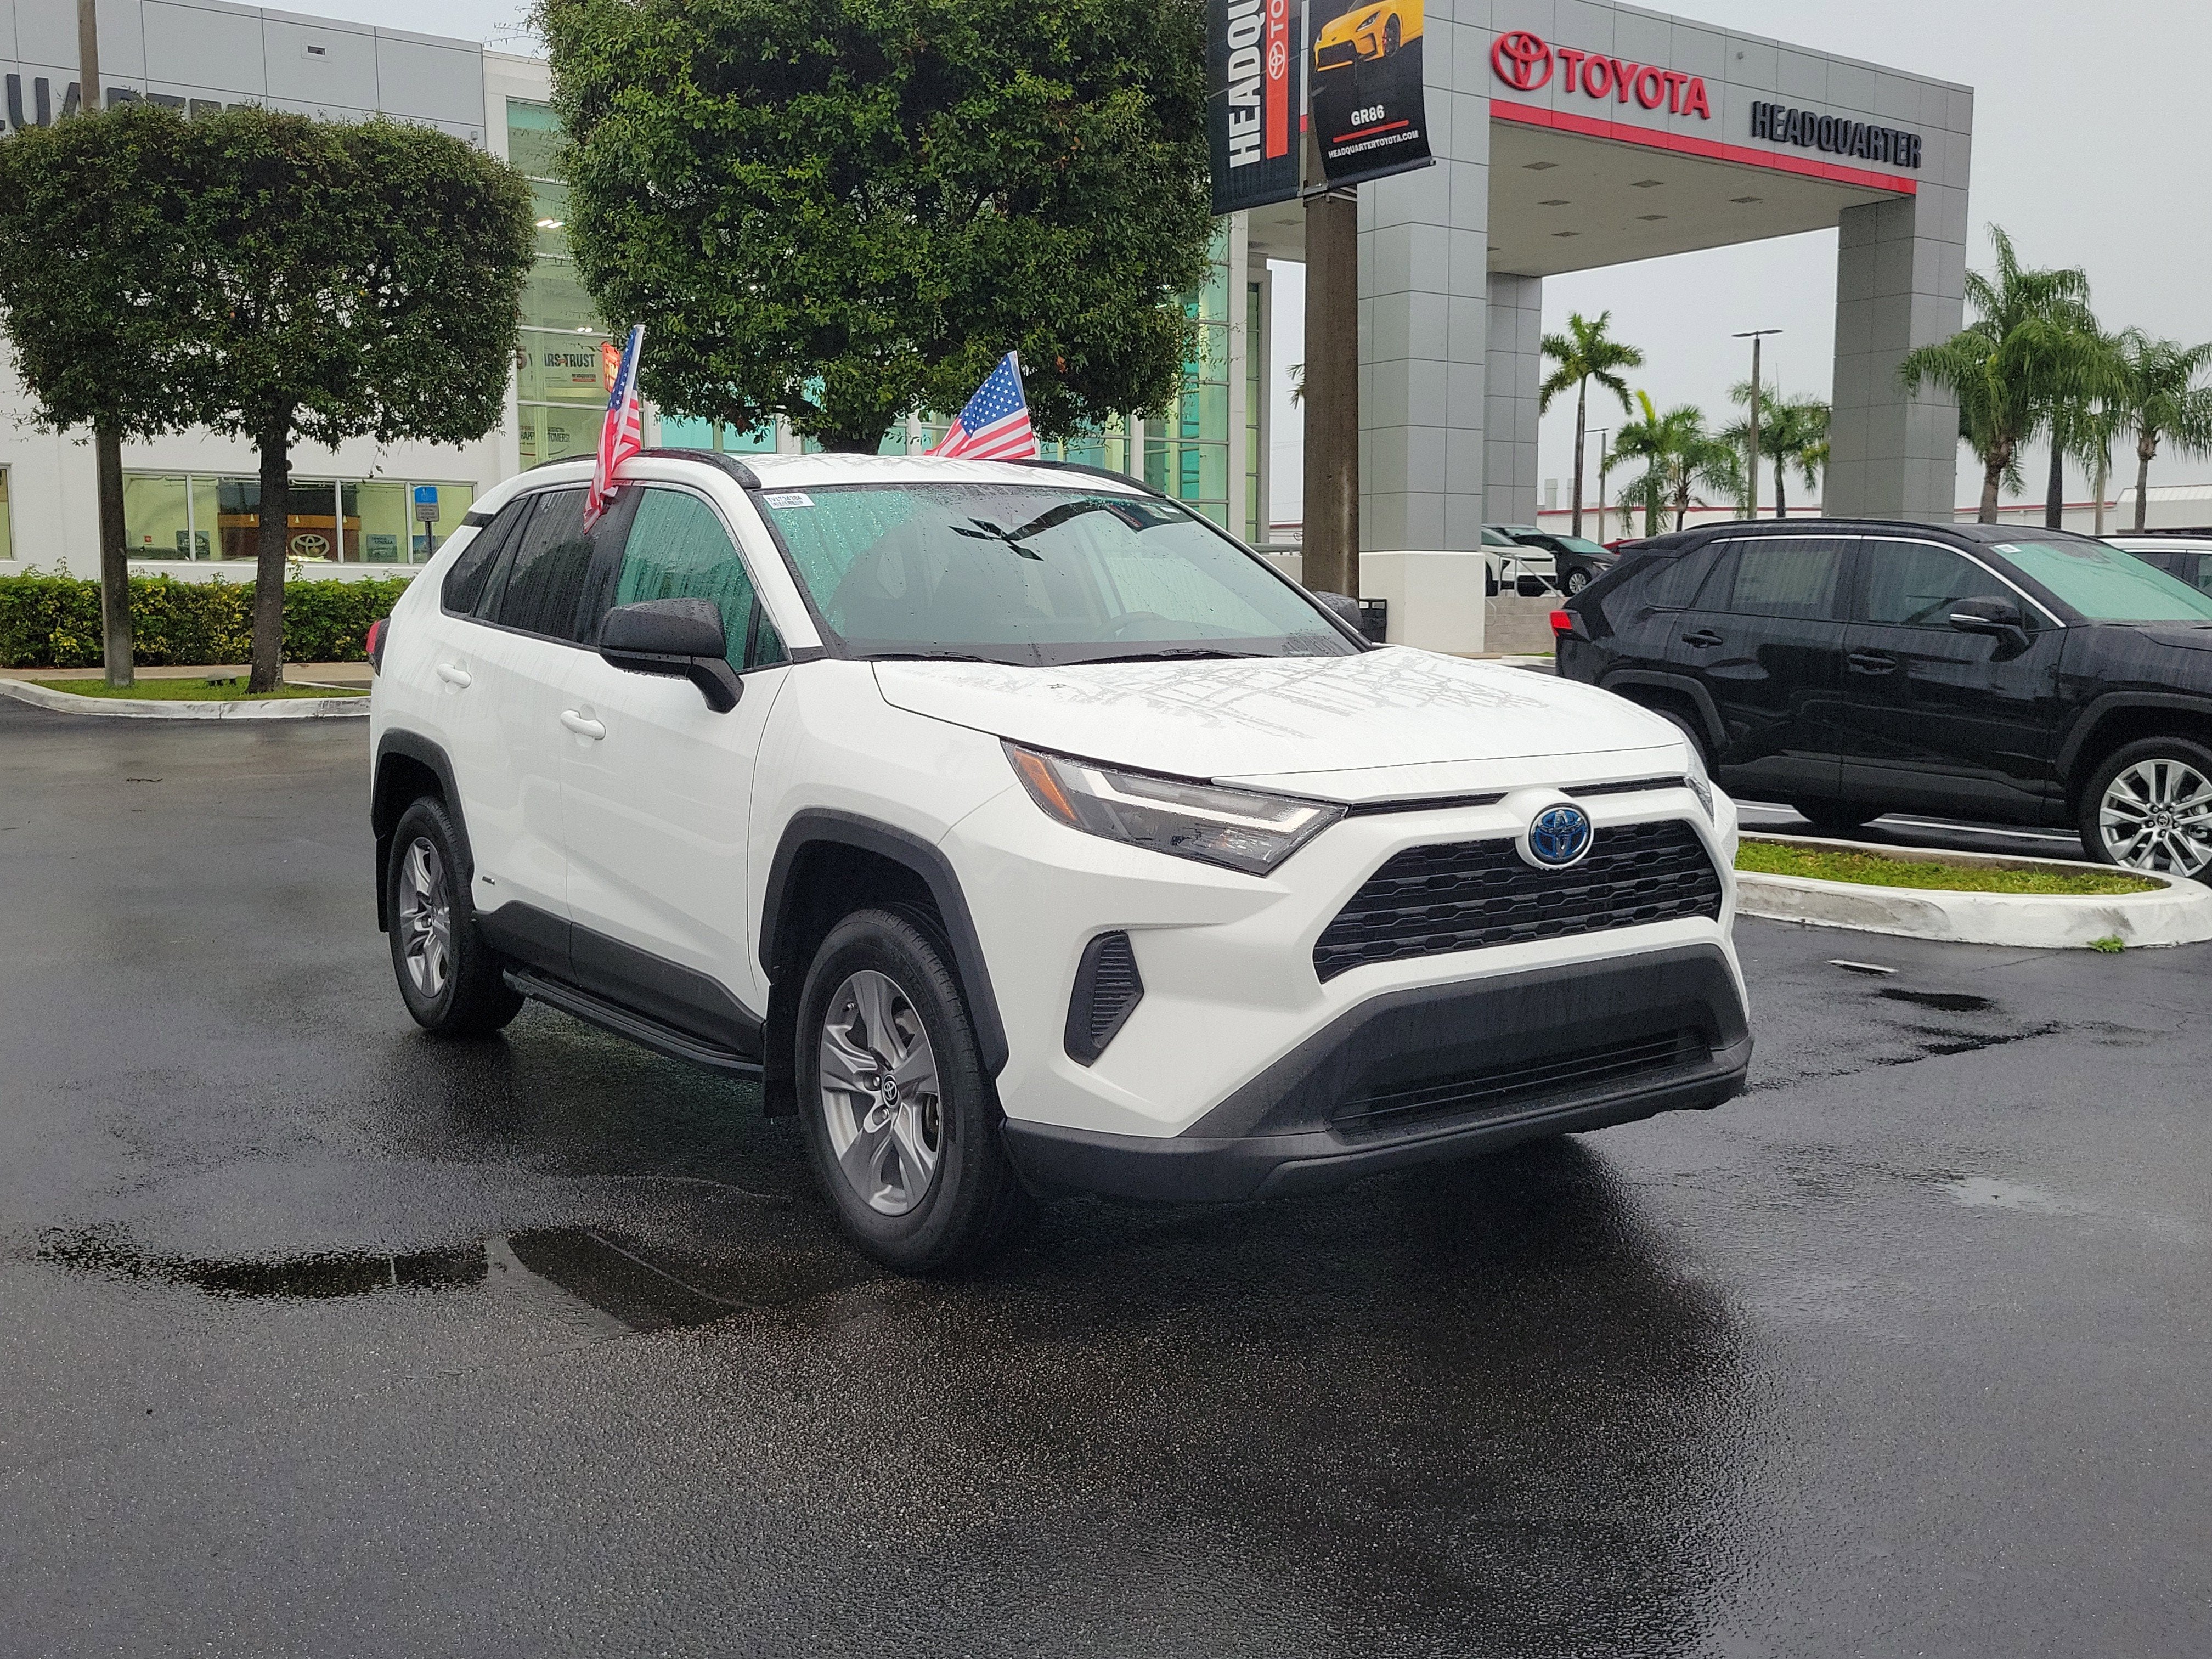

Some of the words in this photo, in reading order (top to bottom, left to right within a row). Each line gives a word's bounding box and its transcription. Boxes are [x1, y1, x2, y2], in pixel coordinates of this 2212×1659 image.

[1351, 104, 1386, 126] GR86
[1558, 48, 1711, 120] TOYOTA
[1751, 101, 1922, 169] HEADQUARTER
[1328, 129, 1420, 159] HEADQUARTERTOYOTA.COM
[563, 353, 595, 368] TRUST
